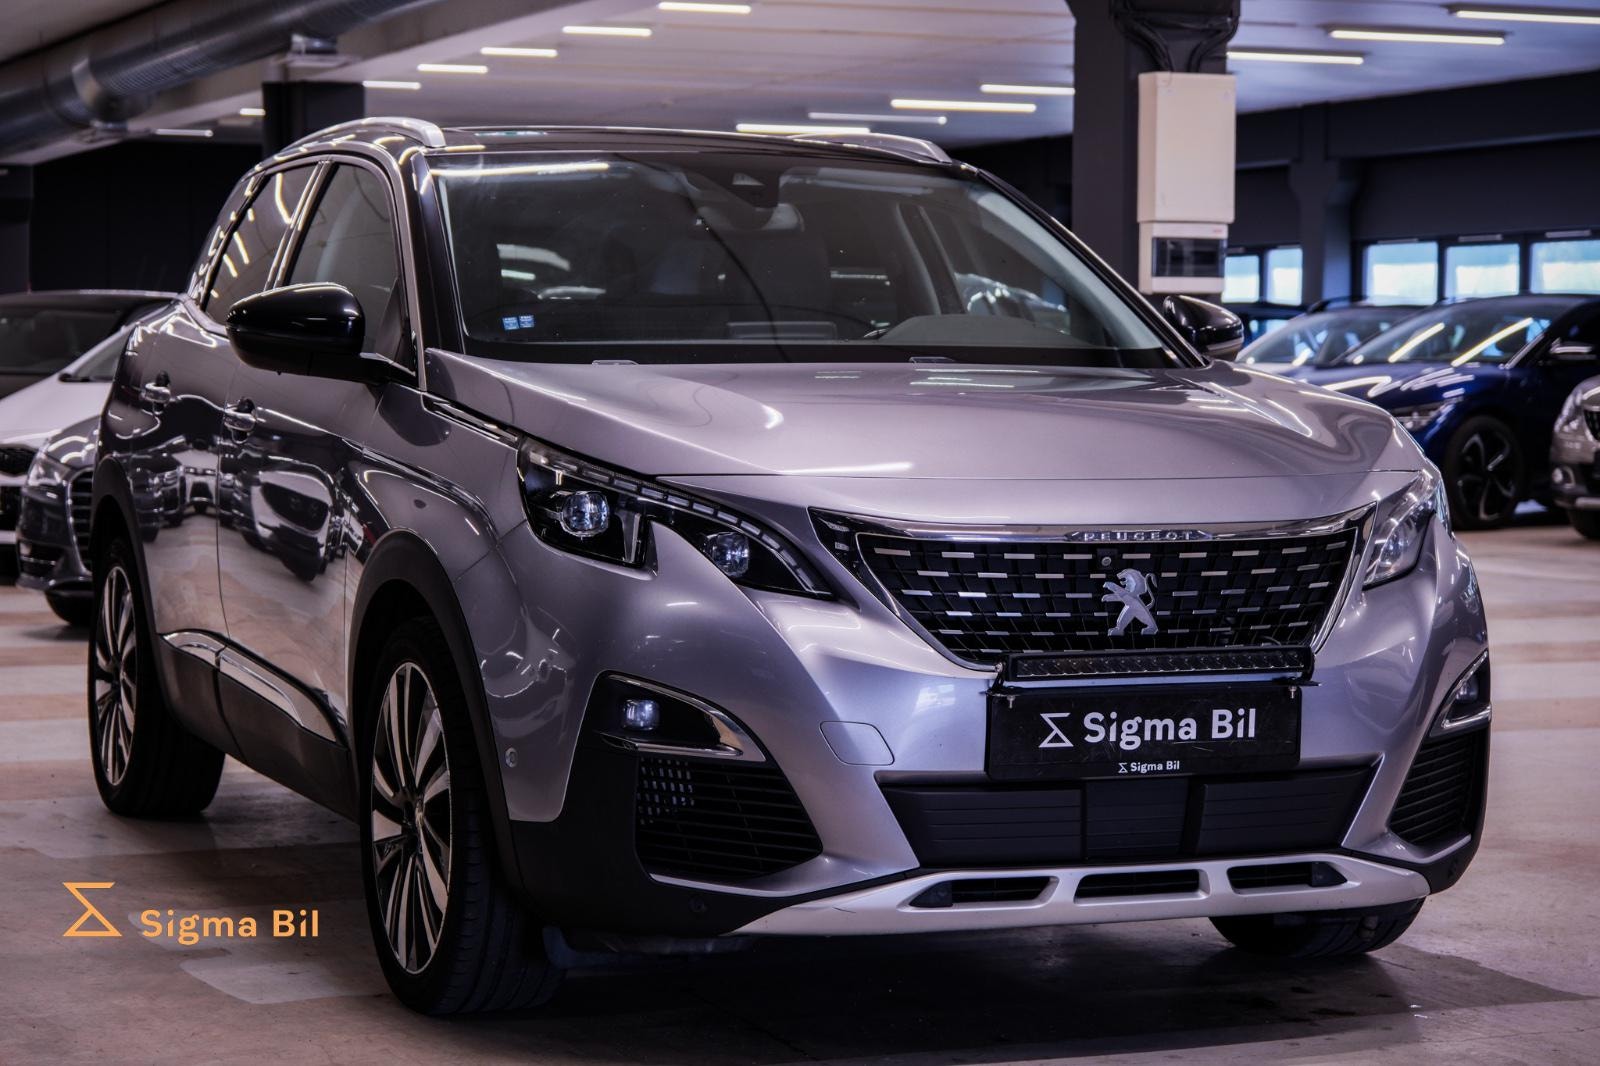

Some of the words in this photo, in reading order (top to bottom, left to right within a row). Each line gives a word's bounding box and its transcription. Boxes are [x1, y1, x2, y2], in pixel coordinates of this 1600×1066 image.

[1084, 531, 1193, 541] PEUGEOT
[1083, 711, 1197, 750] Sigma
[1211, 708, 1256, 739] Bil
[1130, 762, 1163, 774] Sigma
[1166, 760, 1180, 770] Bil
